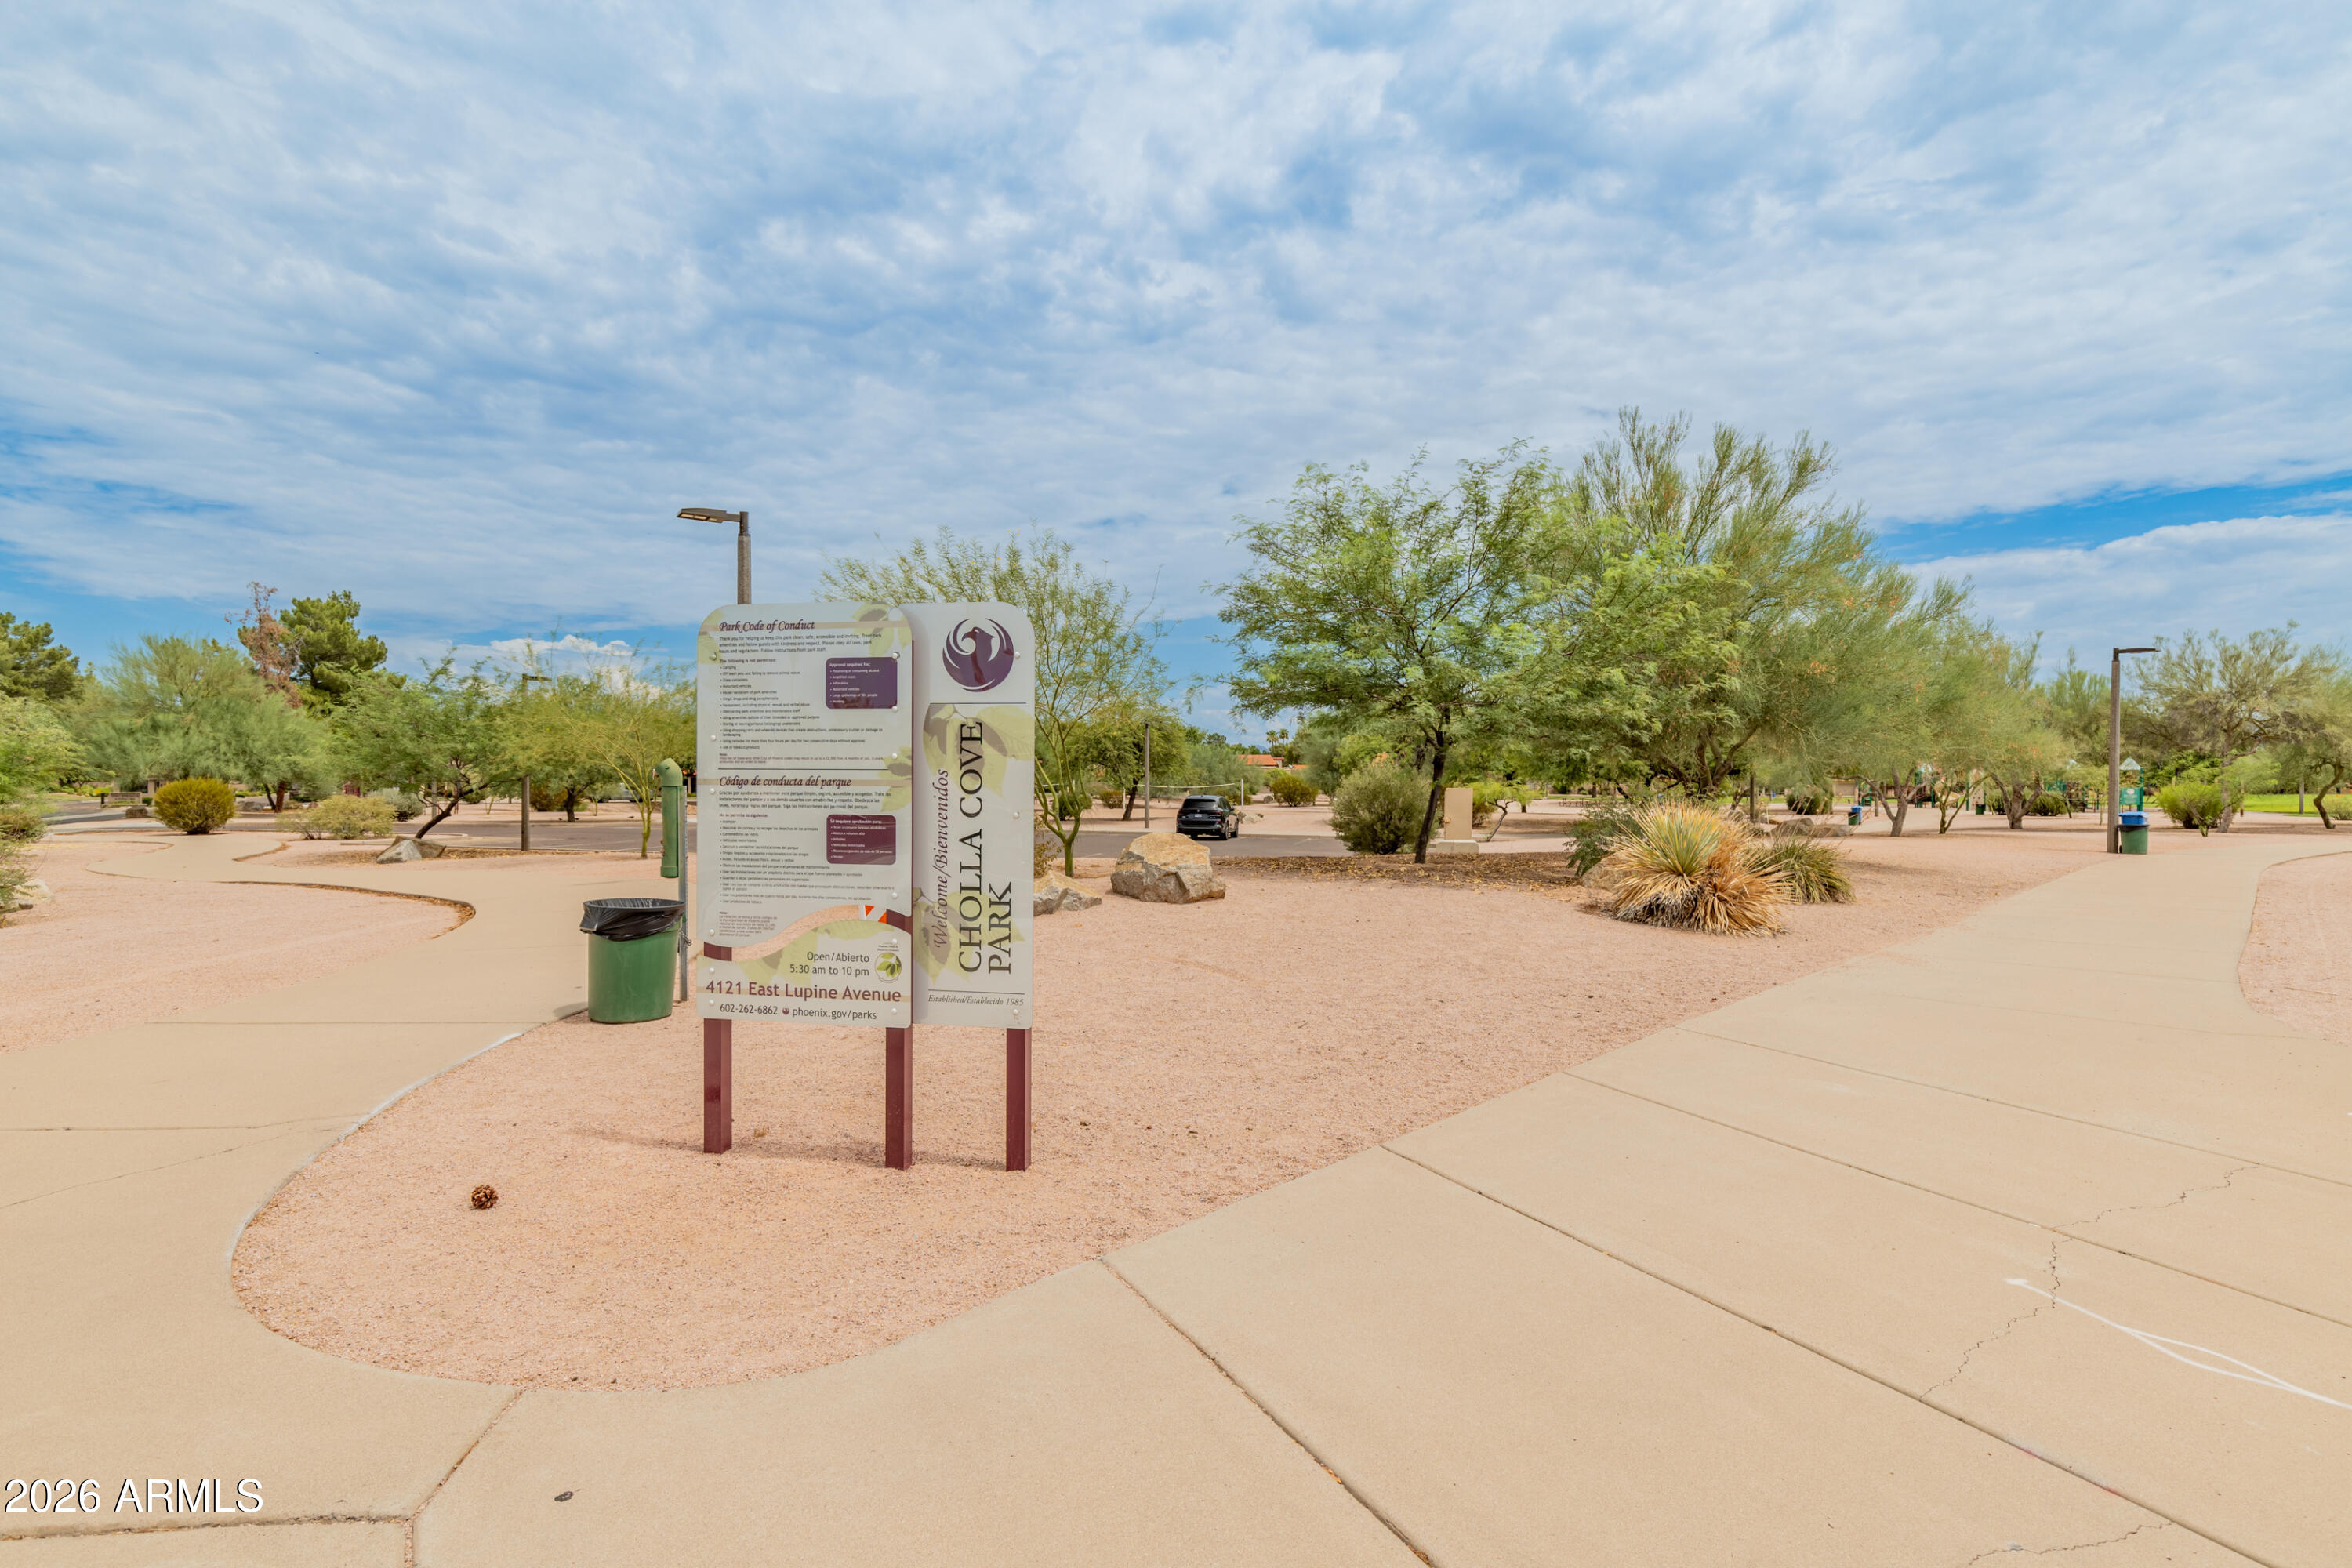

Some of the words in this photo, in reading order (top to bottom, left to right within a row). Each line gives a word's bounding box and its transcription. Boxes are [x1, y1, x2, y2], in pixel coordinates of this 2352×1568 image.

[719, 621, 742, 633] Park
[743, 620, 764, 632] Code
[766, 620, 778, 633] of
[778, 619, 815, 631] Conduct
[959, 722, 983, 818] COVE
[719, 775, 749, 789] Código
[750, 775, 761, 786] de
[763, 775, 803, 786] conducta
[805, 775, 821, 786] del
[820, 779, 851, 789] parque
[932, 769, 951, 948] Welcome/Bienvenidos
[958, 828, 982, 972] CHOLLA
[987, 881, 1011, 974] PARK
[807, 952, 869, 963] Open/Abierto
[790, 965, 809, 974] 5:30
[829, 967, 838, 975] to
[842, 967, 852, 975] 10
[855, 969, 869, 978] pm
[706, 981, 742, 995] 4121
[749, 982, 779, 996] East
[785, 984, 838, 1001] Lupine
[842, 986, 902, 1002] Avenue
[928, 995, 1003, 1005] Established/Establecido
[720, 1004, 778, 1015] 602-262-6862
[792, 1007, 877, 1020] phoenix.gov/parks
